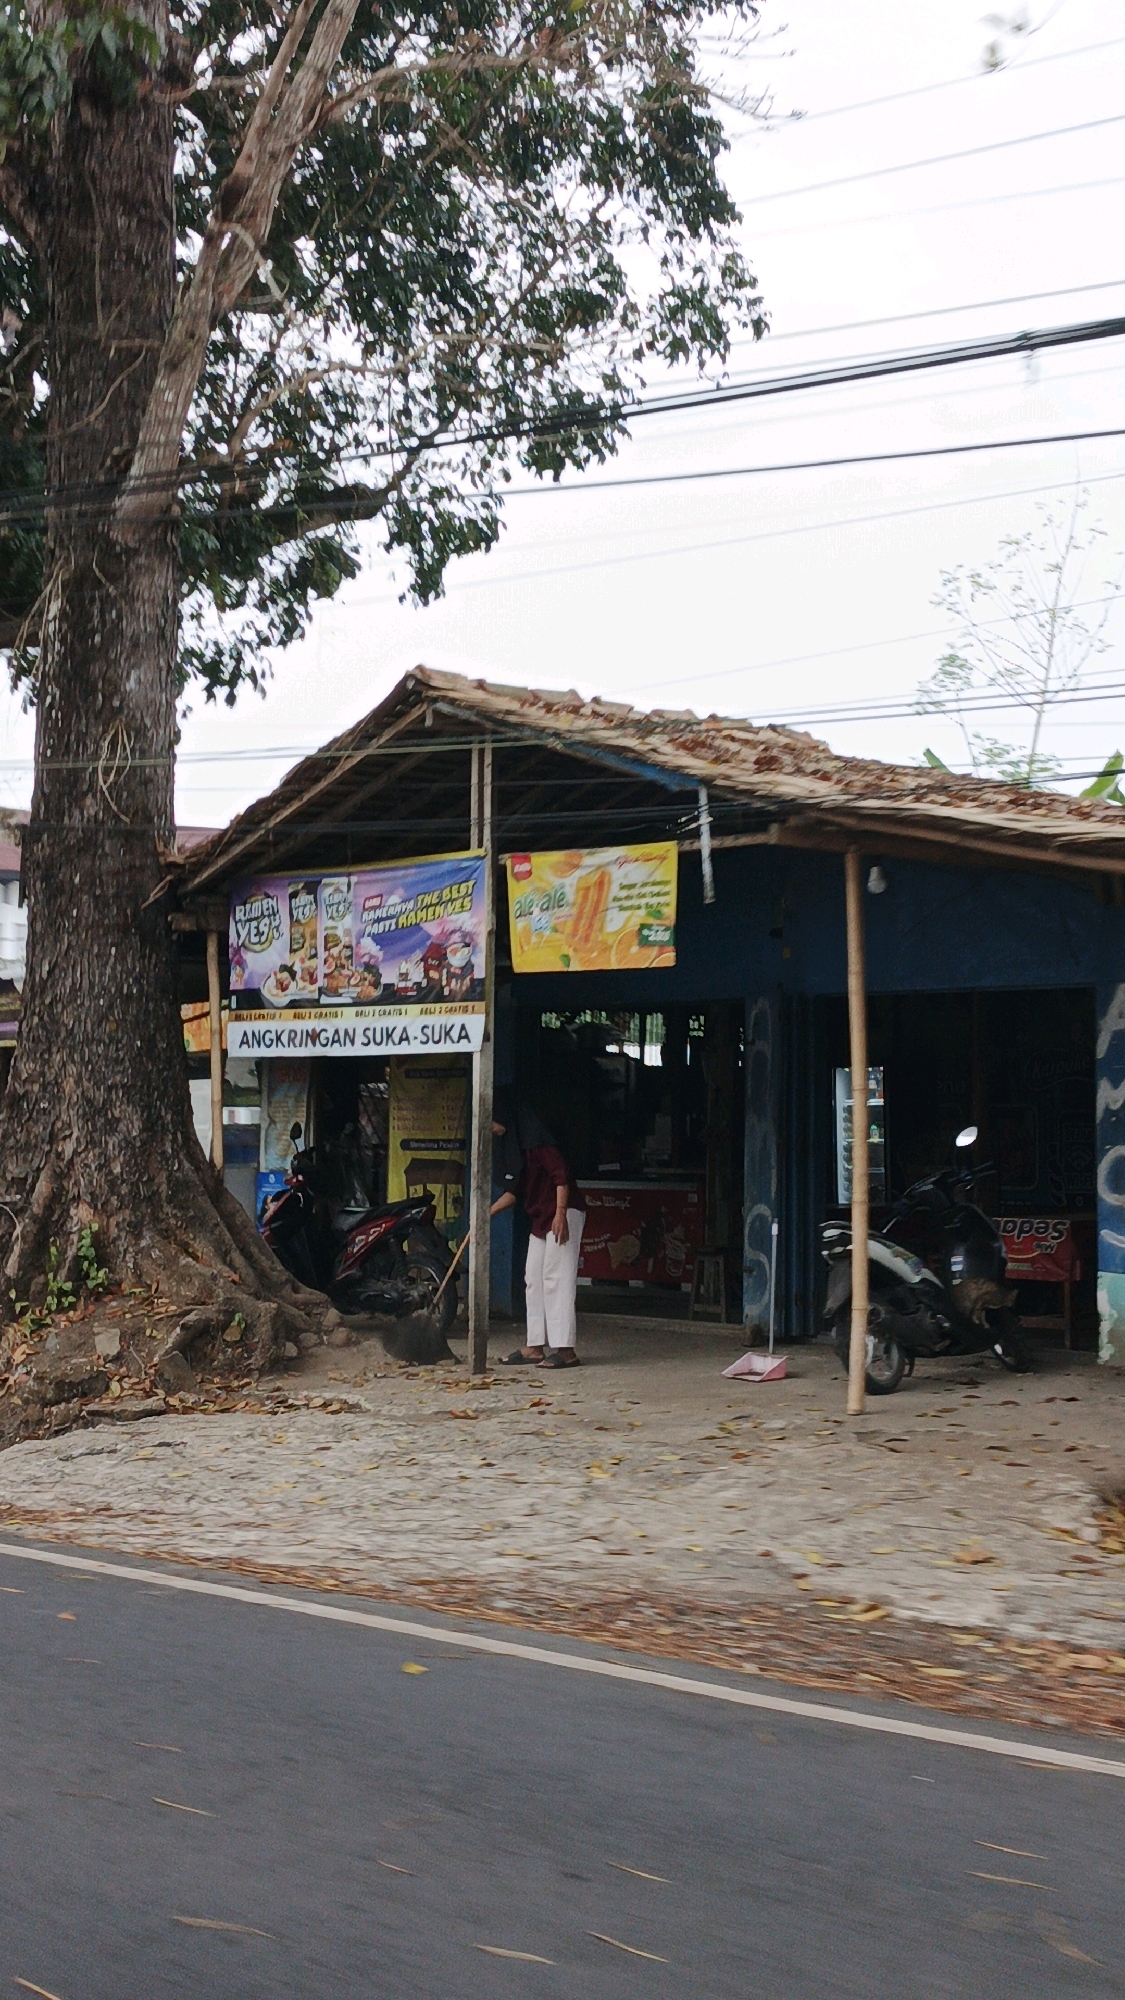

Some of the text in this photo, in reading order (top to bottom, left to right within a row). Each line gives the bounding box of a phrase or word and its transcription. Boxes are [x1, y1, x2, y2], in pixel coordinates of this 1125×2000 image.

[417, 890, 442, 909] THE
[441, 879, 476, 902] BEST
[446, 896, 472, 916] YES
[235, 896, 279, 921] RAMEN
[238, 1023, 471, 1049] ANGKRINGAN SUKA-SUKA
